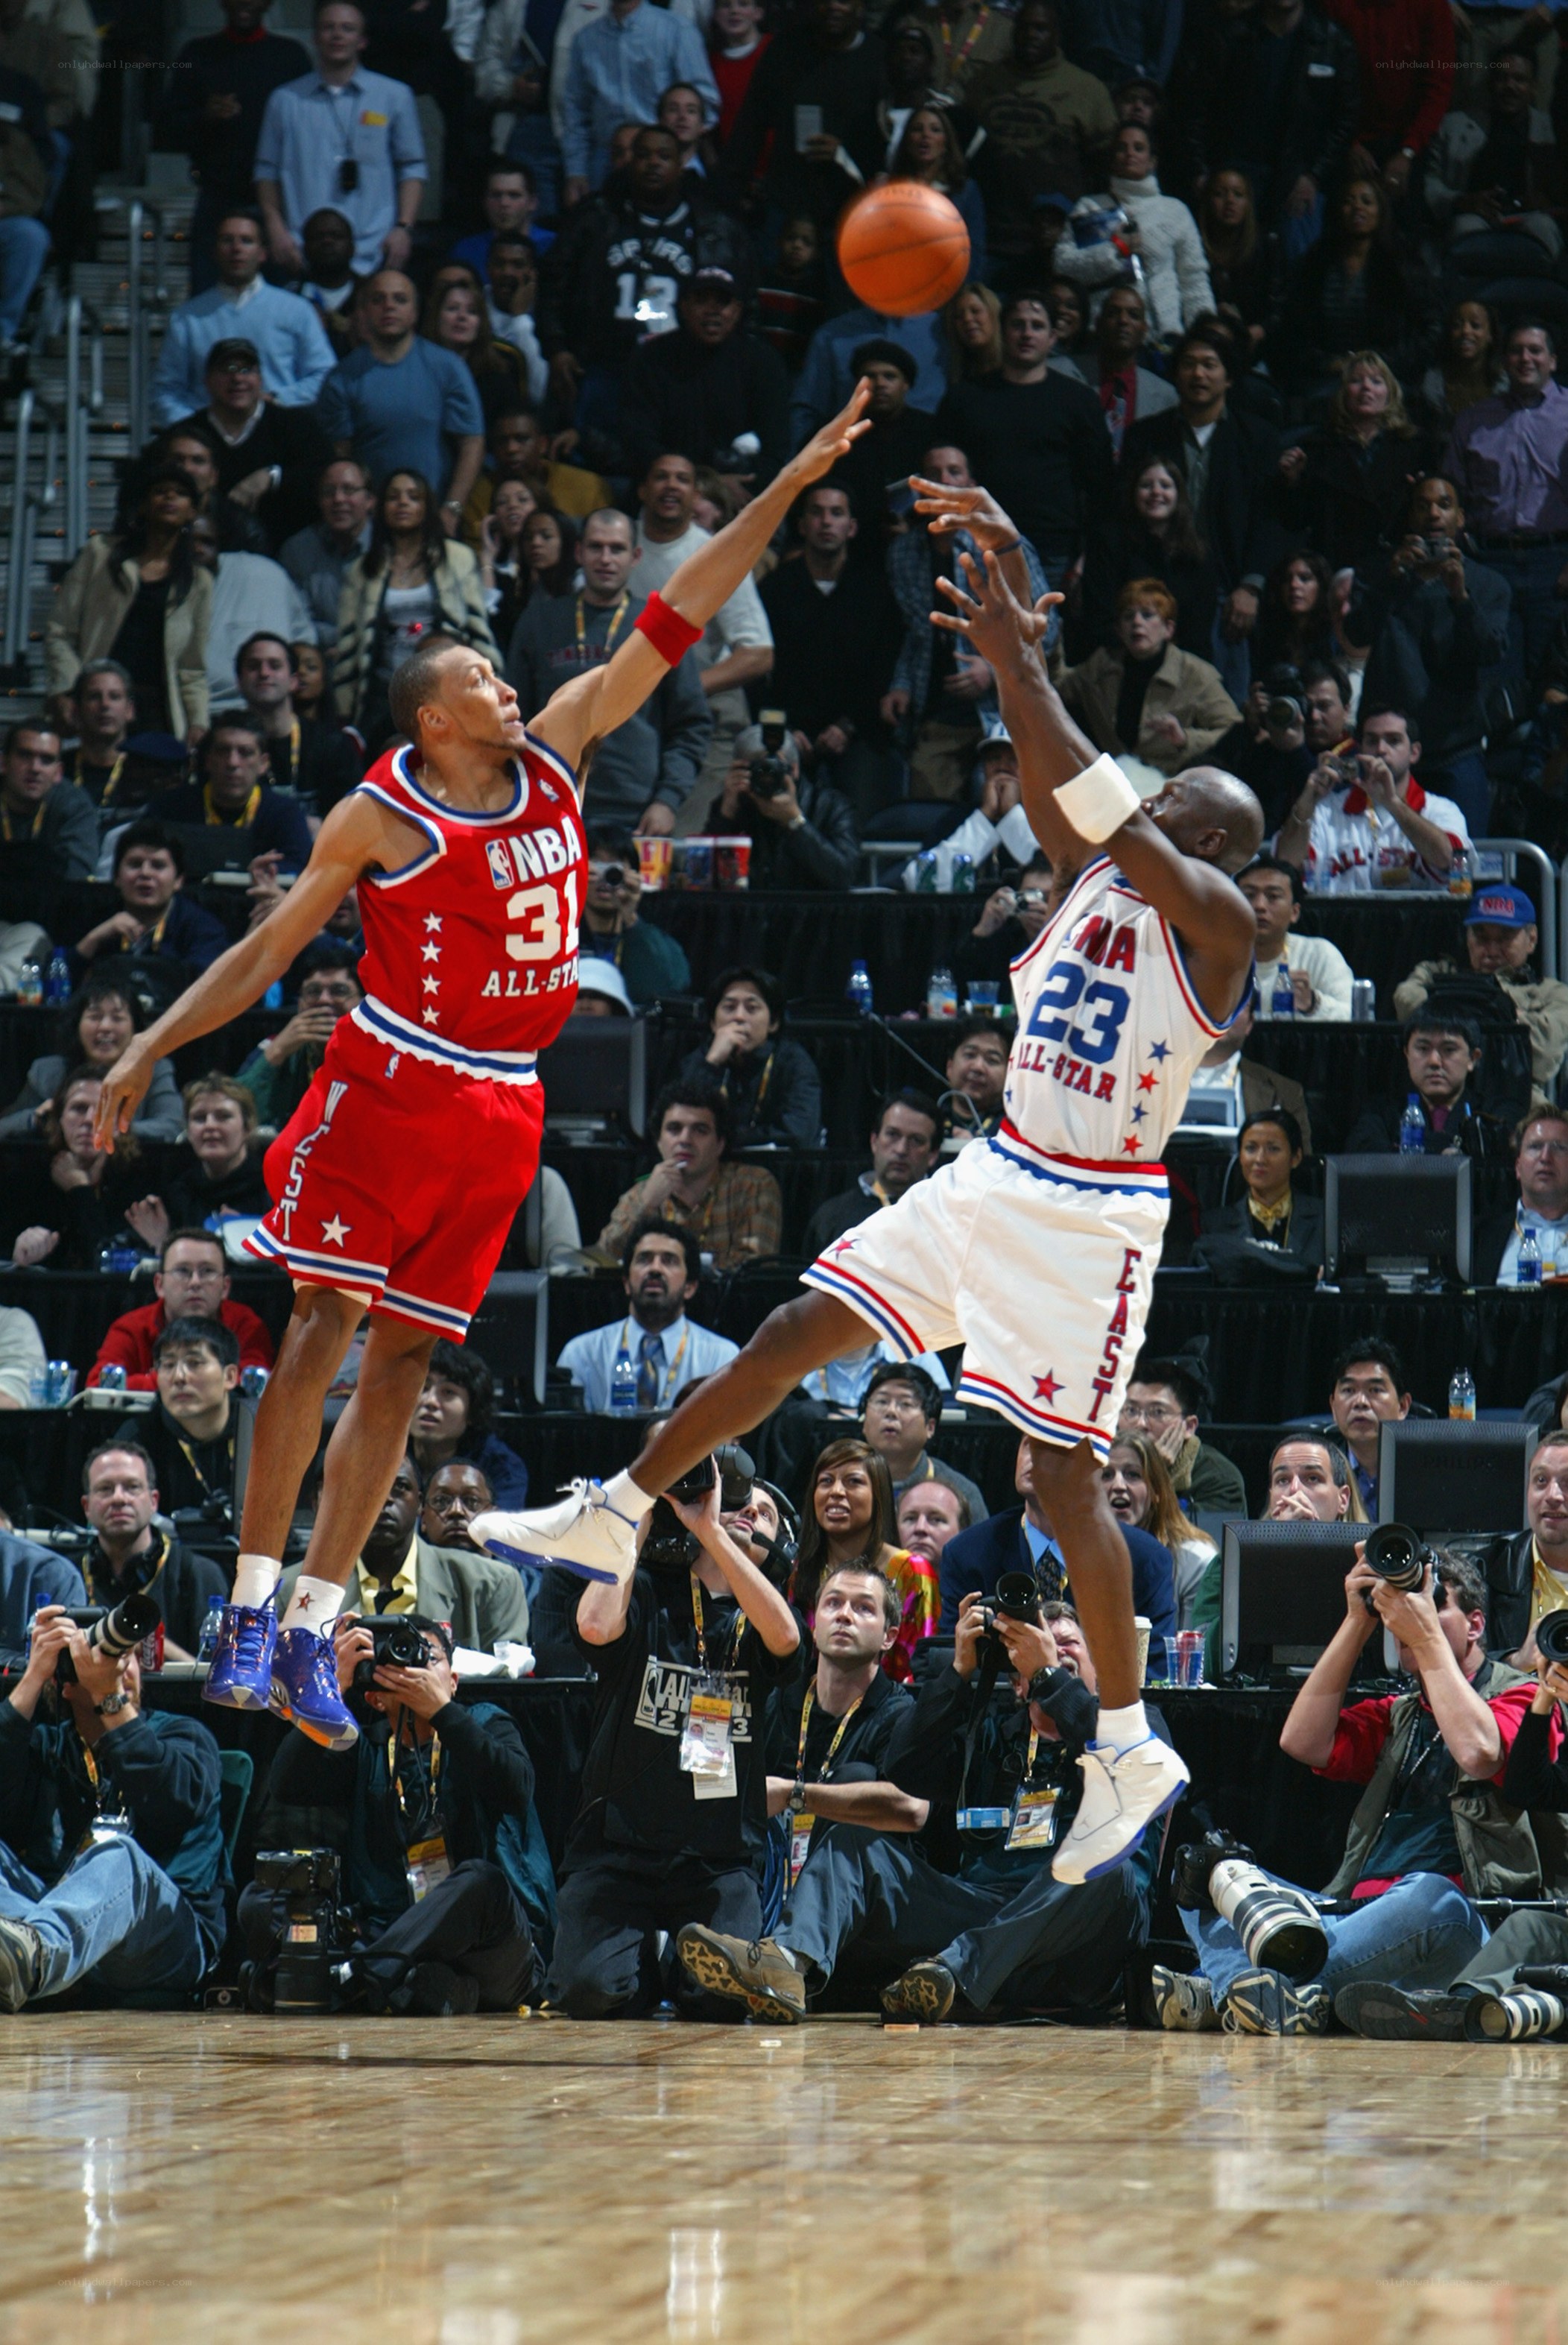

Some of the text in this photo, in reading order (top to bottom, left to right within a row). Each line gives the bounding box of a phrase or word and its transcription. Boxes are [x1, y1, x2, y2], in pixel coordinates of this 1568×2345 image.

[508, 815, 582, 883] NBA
[505, 870, 579, 962] 31
[1482, 896, 1515, 918] NBA
[481, 955, 579, 997] ALL-STA
[1025, 960, 1131, 1065] 23
[1017, 1042, 1117, 1103] LL-STAR
[279, 1080, 349, 1242] WEST
[1086, 1247, 1142, 1423] EAST
[657, 1709, 750, 1737] 23
